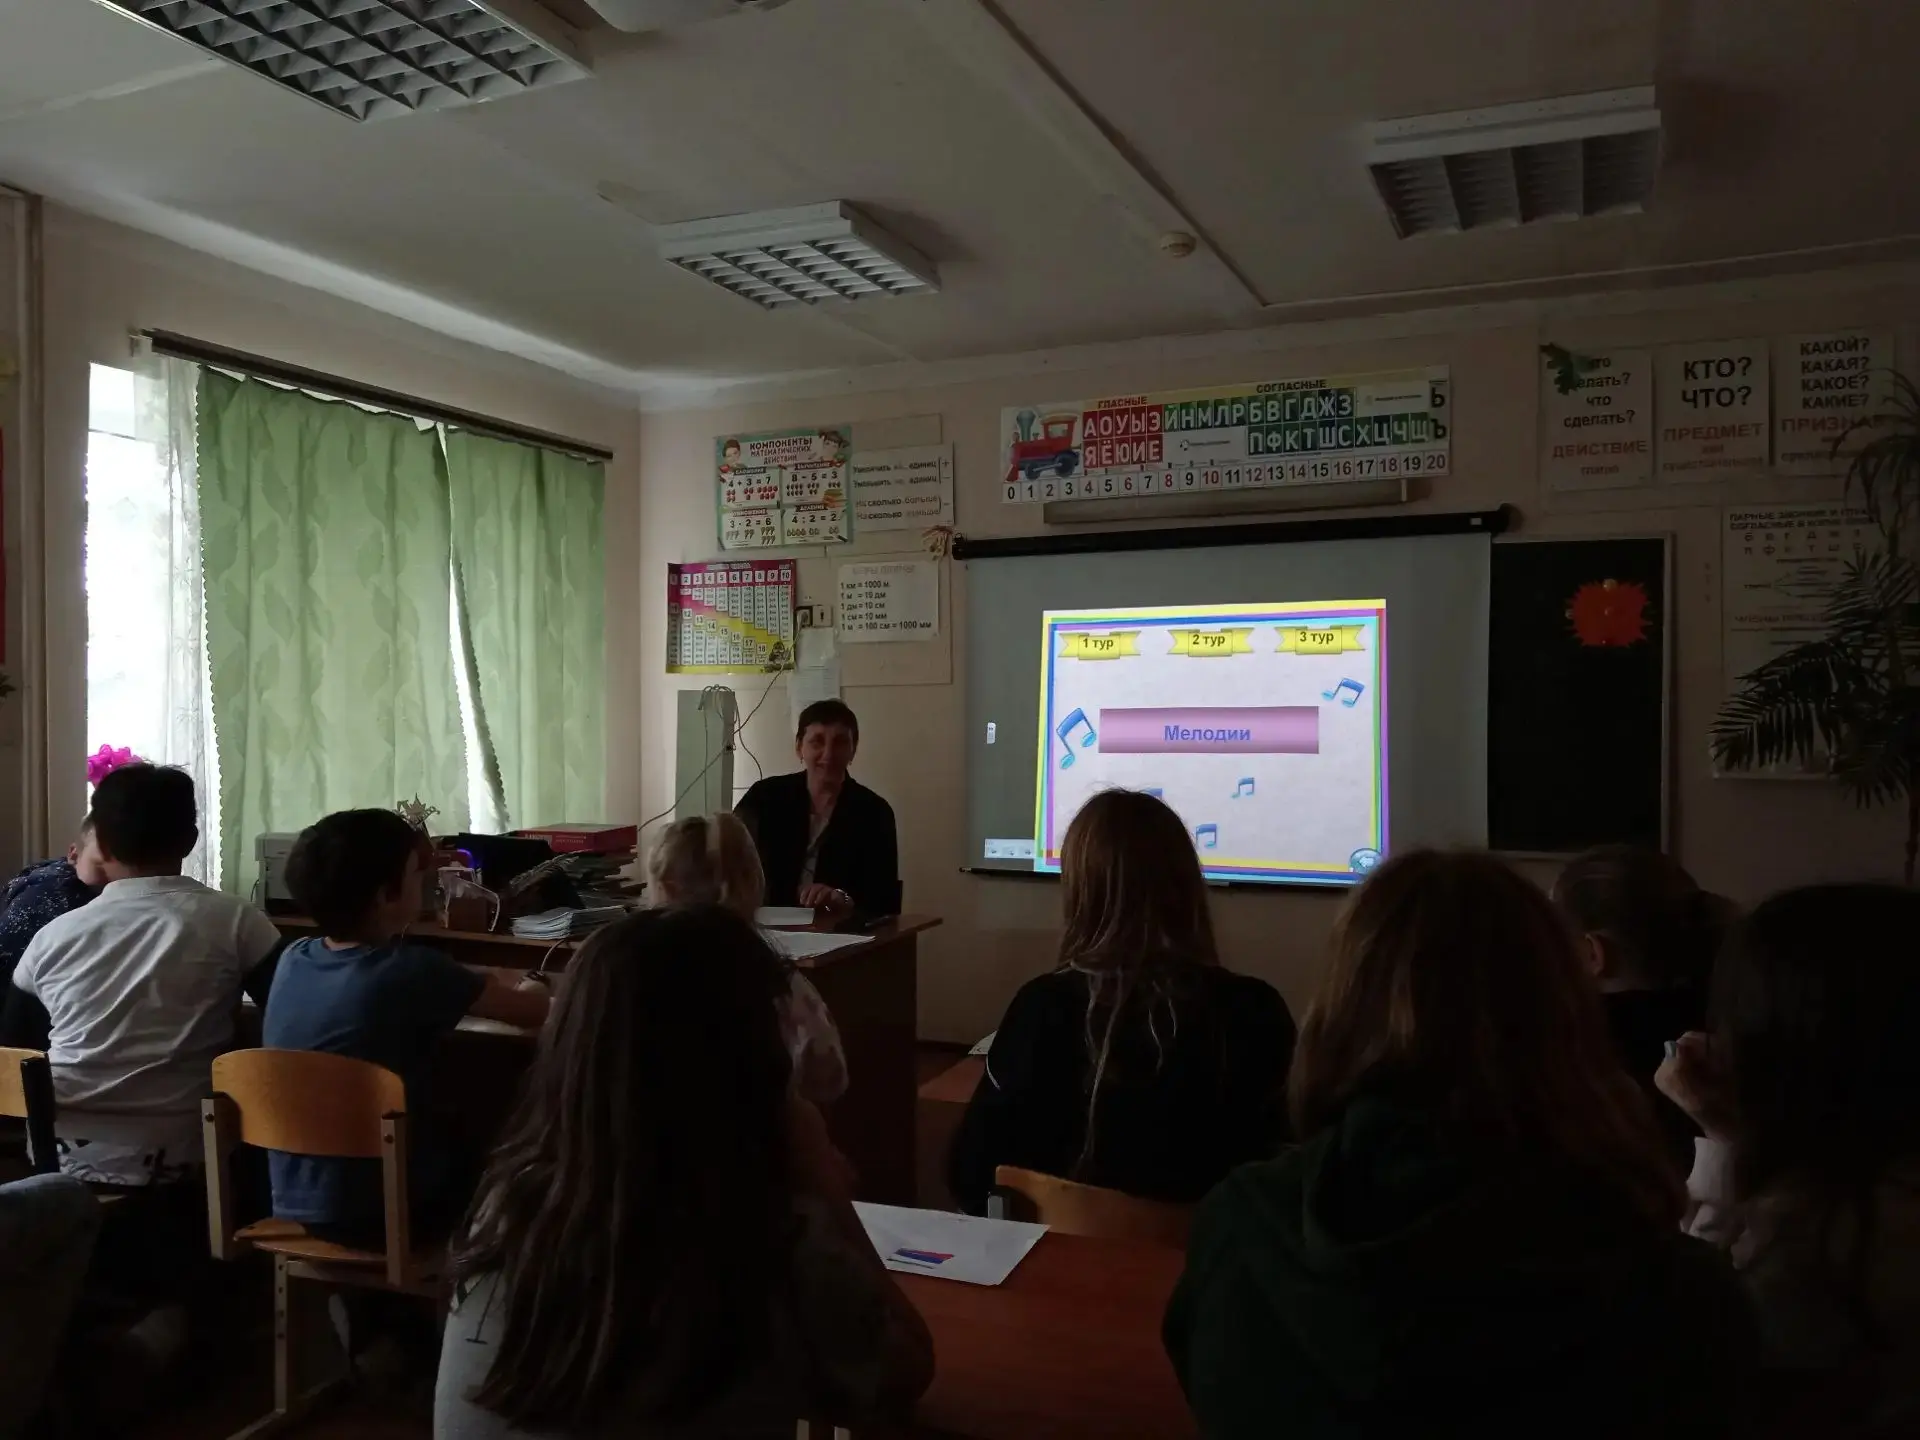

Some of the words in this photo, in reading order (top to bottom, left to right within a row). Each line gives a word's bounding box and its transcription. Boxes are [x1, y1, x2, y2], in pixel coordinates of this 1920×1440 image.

[1800, 337, 1869, 355] КАКОЙ?
[1684, 357, 1752, 380] КТО?
[1801, 357, 1869, 374] КАКАЯ?
[1256, 379, 1327, 394] СОГЛАСНЫЕ
[1801, 375, 1869, 391] КАКОЕ?
[1098, 396, 1148, 409] ГЛАСНЫЕ
[1586, 396, 1611, 406] что
[1682, 386, 1751, 408] ЧТО?
[1802, 394, 1869, 409] КАКИЕ?
[1564, 410, 1635, 428] сделать?
[1663, 423, 1764, 441] ПРЕДМЕТ
[750, 437, 812, 450] КОМПОНЕНТЫ
[792, 474, 797, 482] 8
[1008, 487, 1015, 499] 0
[1028, 486, 1033, 498] 1
[1046, 485, 1054, 496] 2
[1065, 483, 1073, 495] 3
[1085, 482, 1093, 493] 4
[1105, 479, 1112, 492] 5
[1125, 478, 1132, 490] 6
[1145, 476, 1152, 489] 7
[1165, 475, 1173, 487] 8
[1186, 473, 1193, 486] 9
[1203, 471, 1219, 484] 10
[1225, 470, 1240, 484] 11
[1246, 468, 1262, 482] 12
[1267, 466, 1284, 480] 13
[1289, 465, 1306, 479] 14
[1311, 463, 1329, 477] 15
[1334, 461, 1351, 476] 16
[1357, 460, 1374, 474] 17
[1379, 458, 1397, 472] 18
[1403, 456, 1421, 471] 19
[1427, 455, 1445, 470] 20
[746, 519, 751, 527] 2
[1730, 512, 1774, 521] ПАРНЫЕ
[864, 580, 881, 588] 1000
[900, 621, 917, 629] 1000
[745, 639, 752, 647] 17
[1083, 638, 1088, 648] 1
[1094, 639, 1114, 650] тур
[1192, 634, 1199, 645] 2
[1204, 636, 1225, 648] тур
[1300, 632, 1307, 642] 3
[1312, 633, 1334, 645] тур
[1164, 725, 1251, 743] Мелодии
